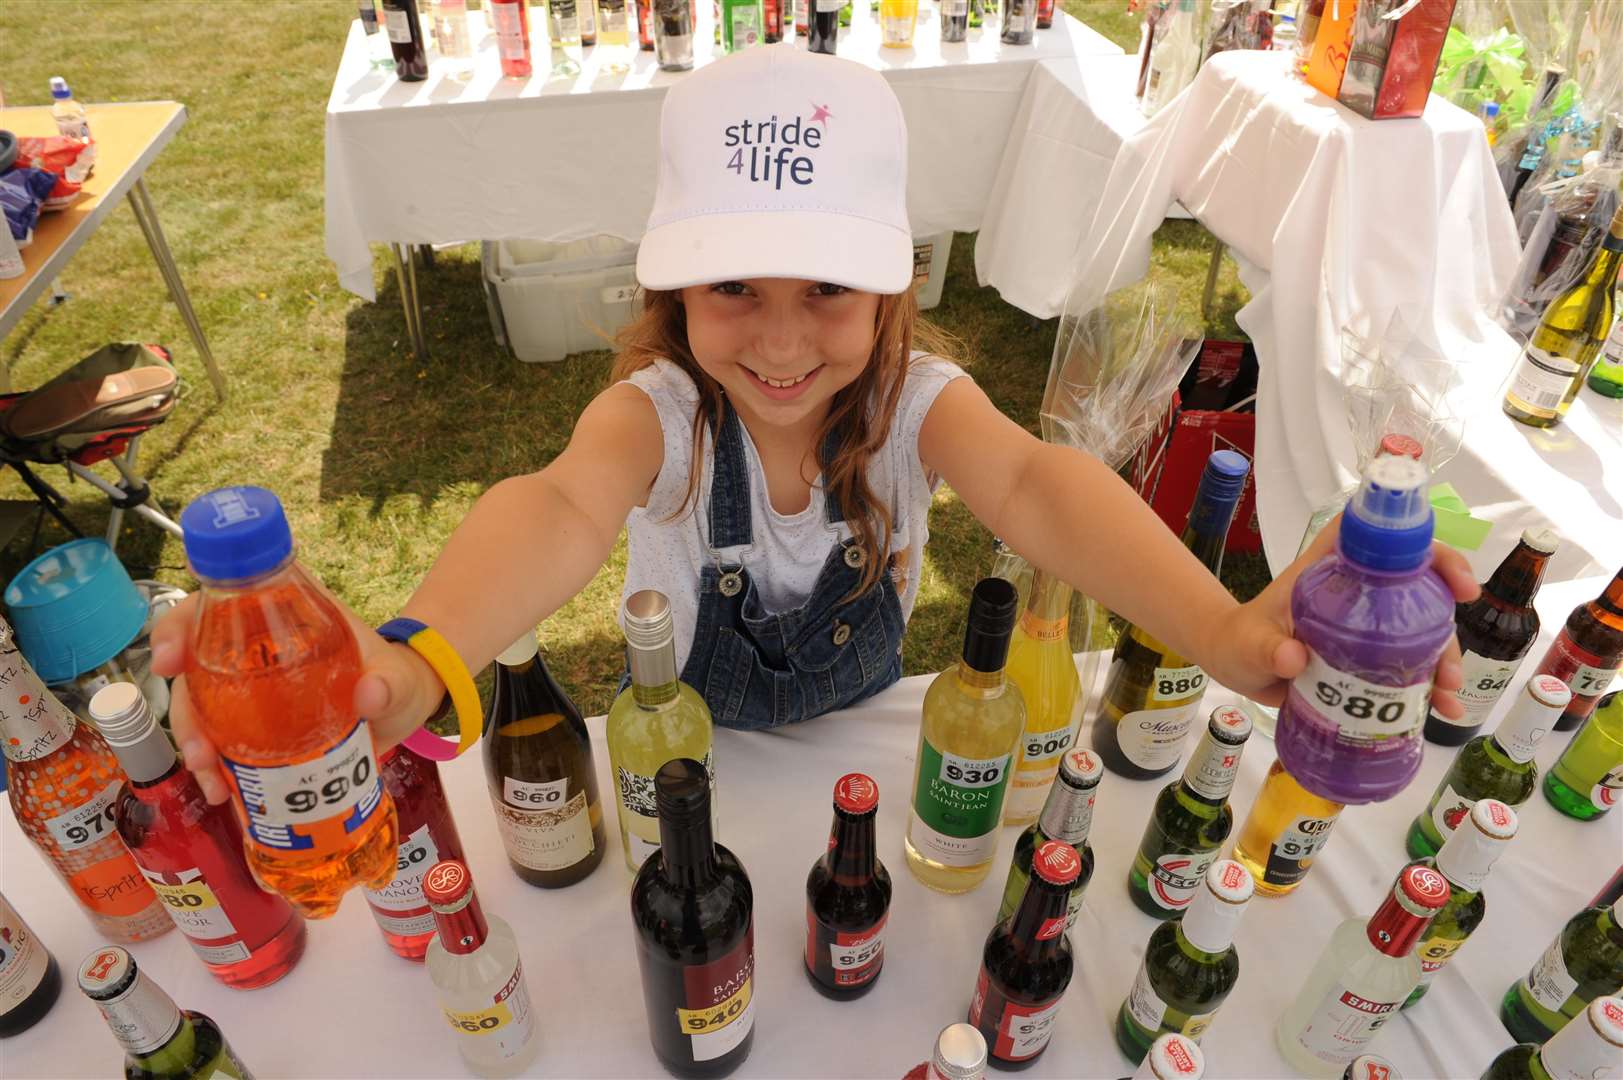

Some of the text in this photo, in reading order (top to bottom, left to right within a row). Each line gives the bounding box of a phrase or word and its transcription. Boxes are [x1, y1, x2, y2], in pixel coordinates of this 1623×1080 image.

[724, 115, 821, 148] stride
[726, 146, 814, 190] 4 life
[1159, 674, 1203, 695] 880
[1477, 675, 1513, 691] 84
[1315, 681, 1405, 724] 980
[1027, 734, 1071, 757] 900
[284, 755, 369, 813] 990
[946, 765, 999, 784] 930
[513, 790, 561, 803] 960
[931, 779, 990, 801] BARON
[935, 838, 968, 848] WHITE
[840, 940, 881, 965] 950
[687, 1000, 743, 1030] 940
